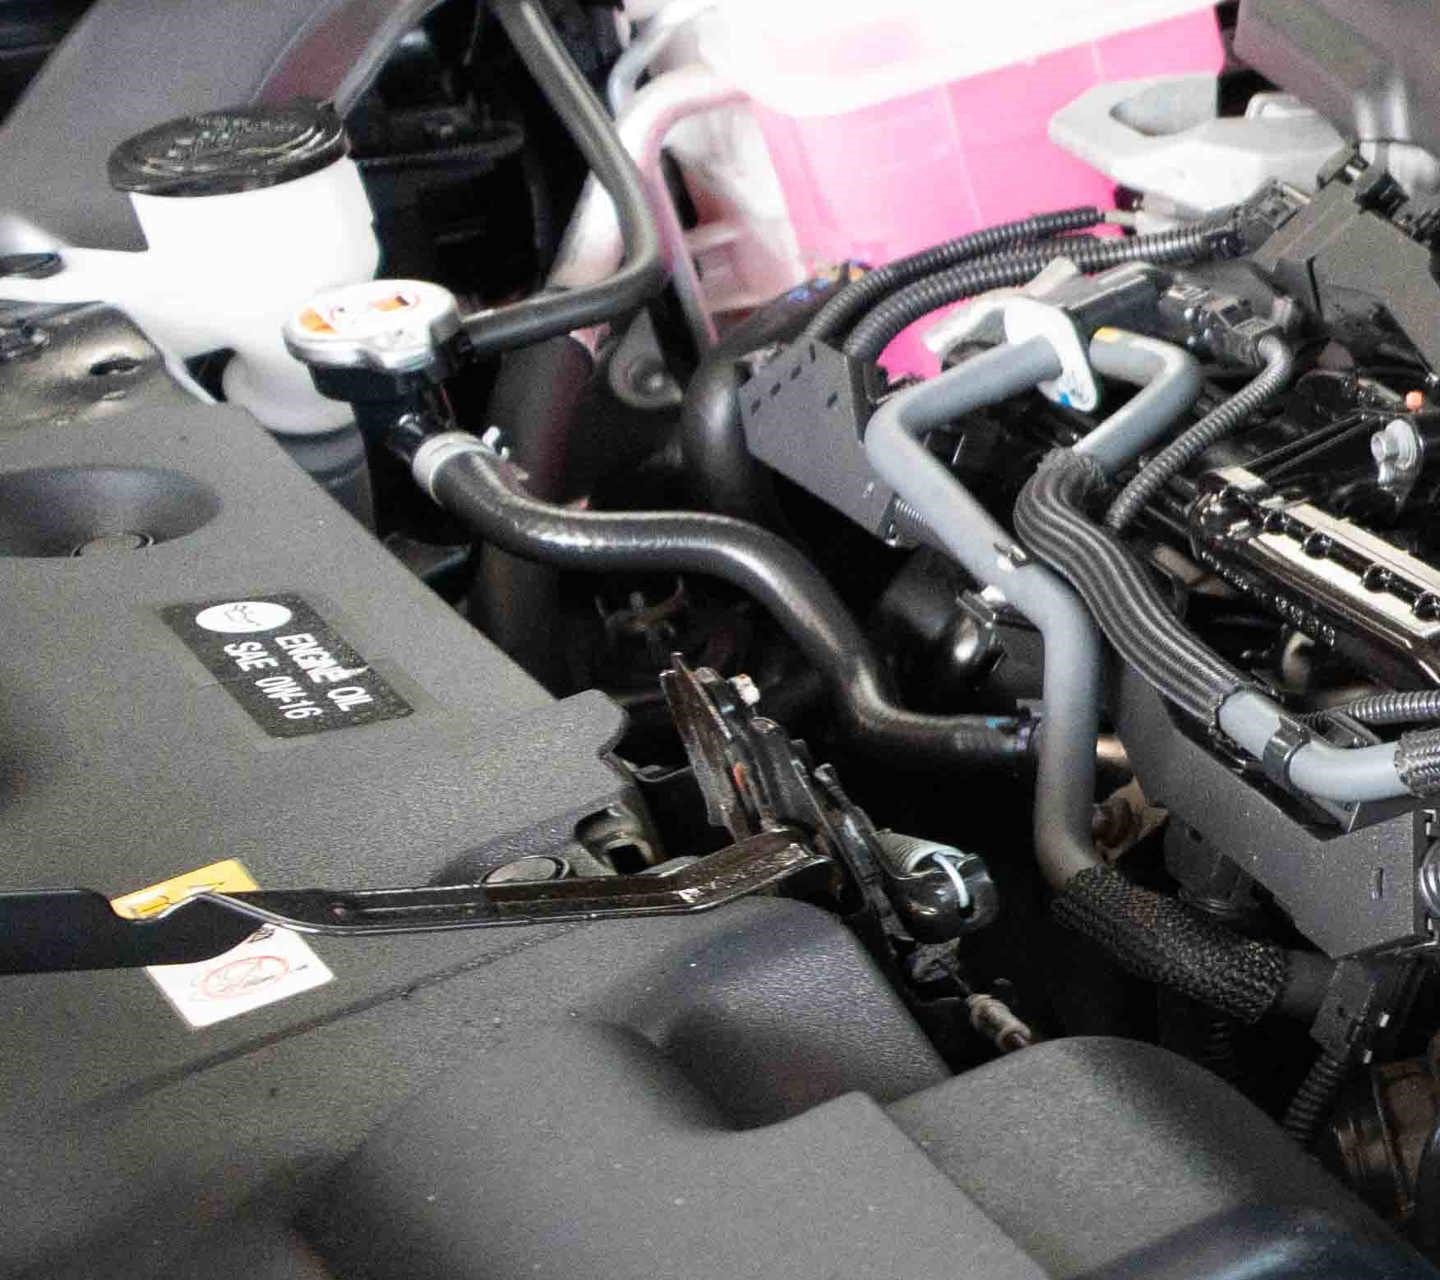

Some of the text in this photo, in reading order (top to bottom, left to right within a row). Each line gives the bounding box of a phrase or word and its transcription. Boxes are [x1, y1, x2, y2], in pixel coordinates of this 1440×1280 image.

[223, 641, 324, 719] SAE 0W-16
[275, 633, 373, 712] ENGINE OIL
